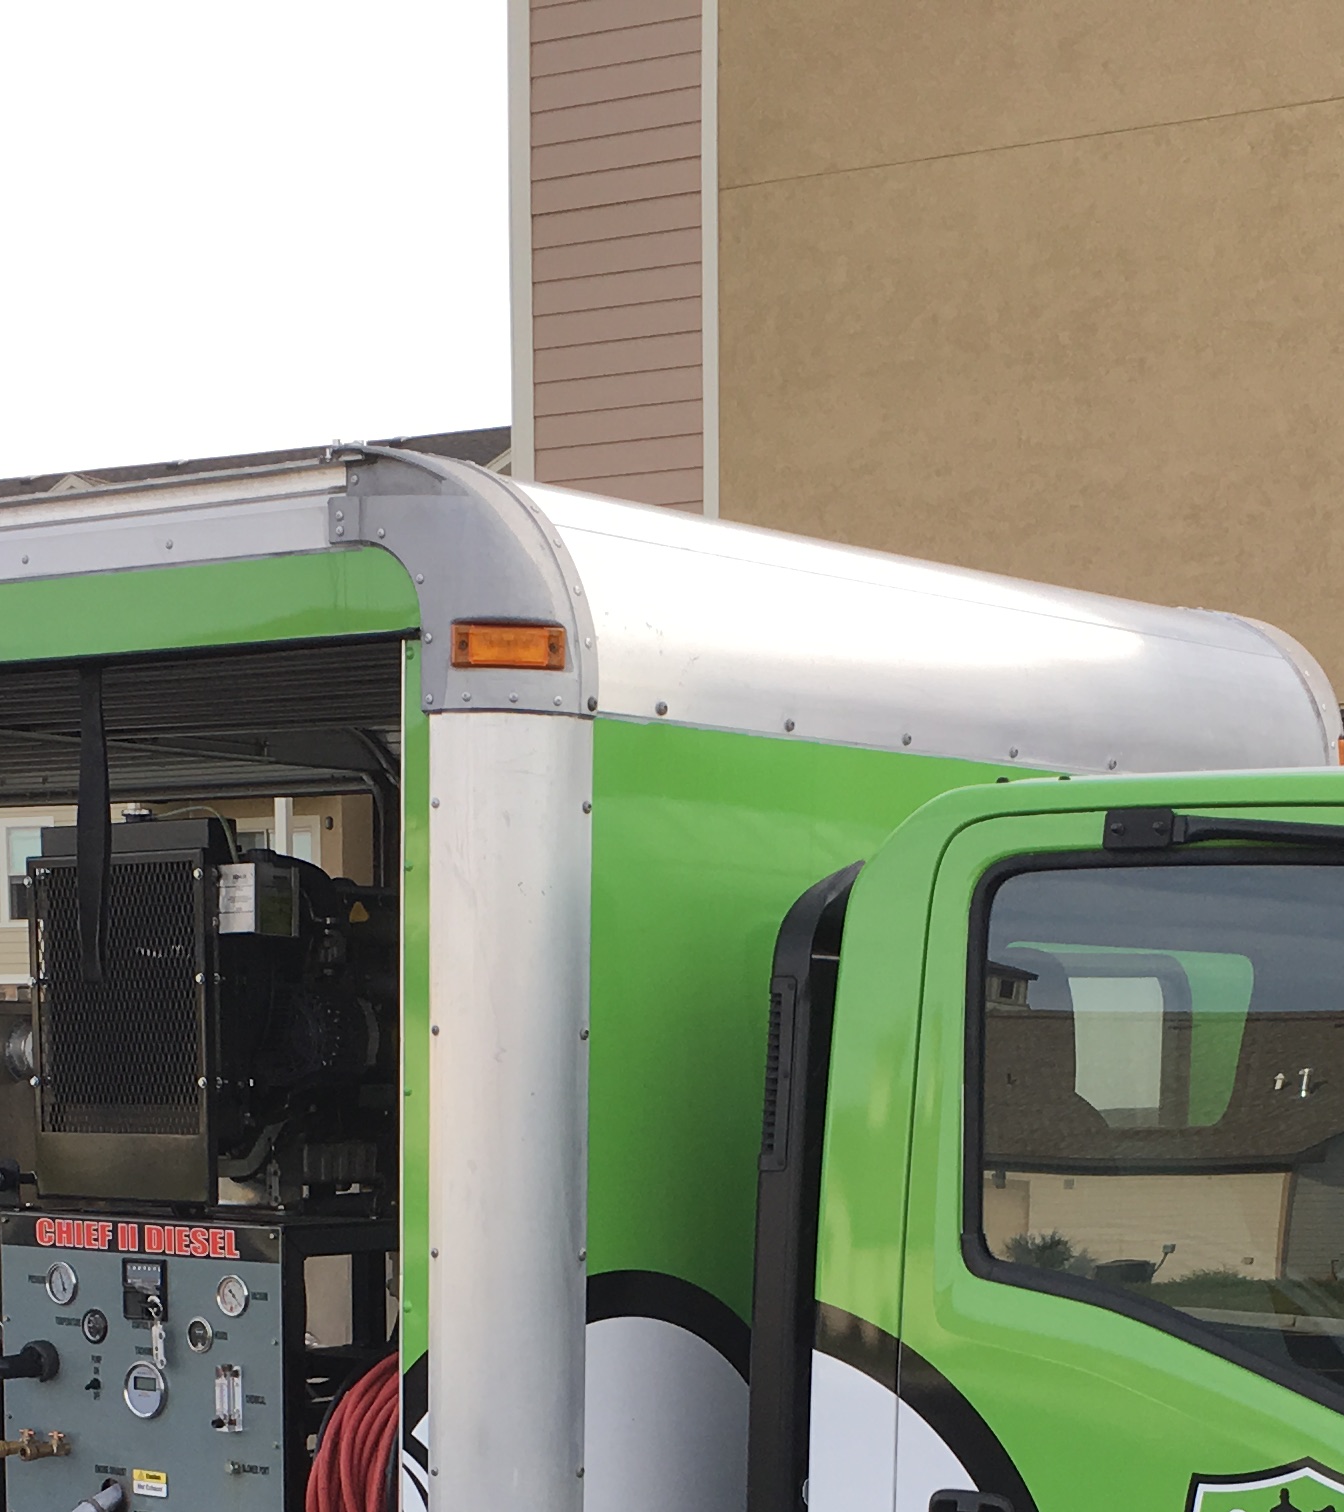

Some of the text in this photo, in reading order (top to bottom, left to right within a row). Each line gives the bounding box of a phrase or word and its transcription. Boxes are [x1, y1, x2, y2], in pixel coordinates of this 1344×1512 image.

[35, 1217, 240, 1259] CHIEF II DIESEL
